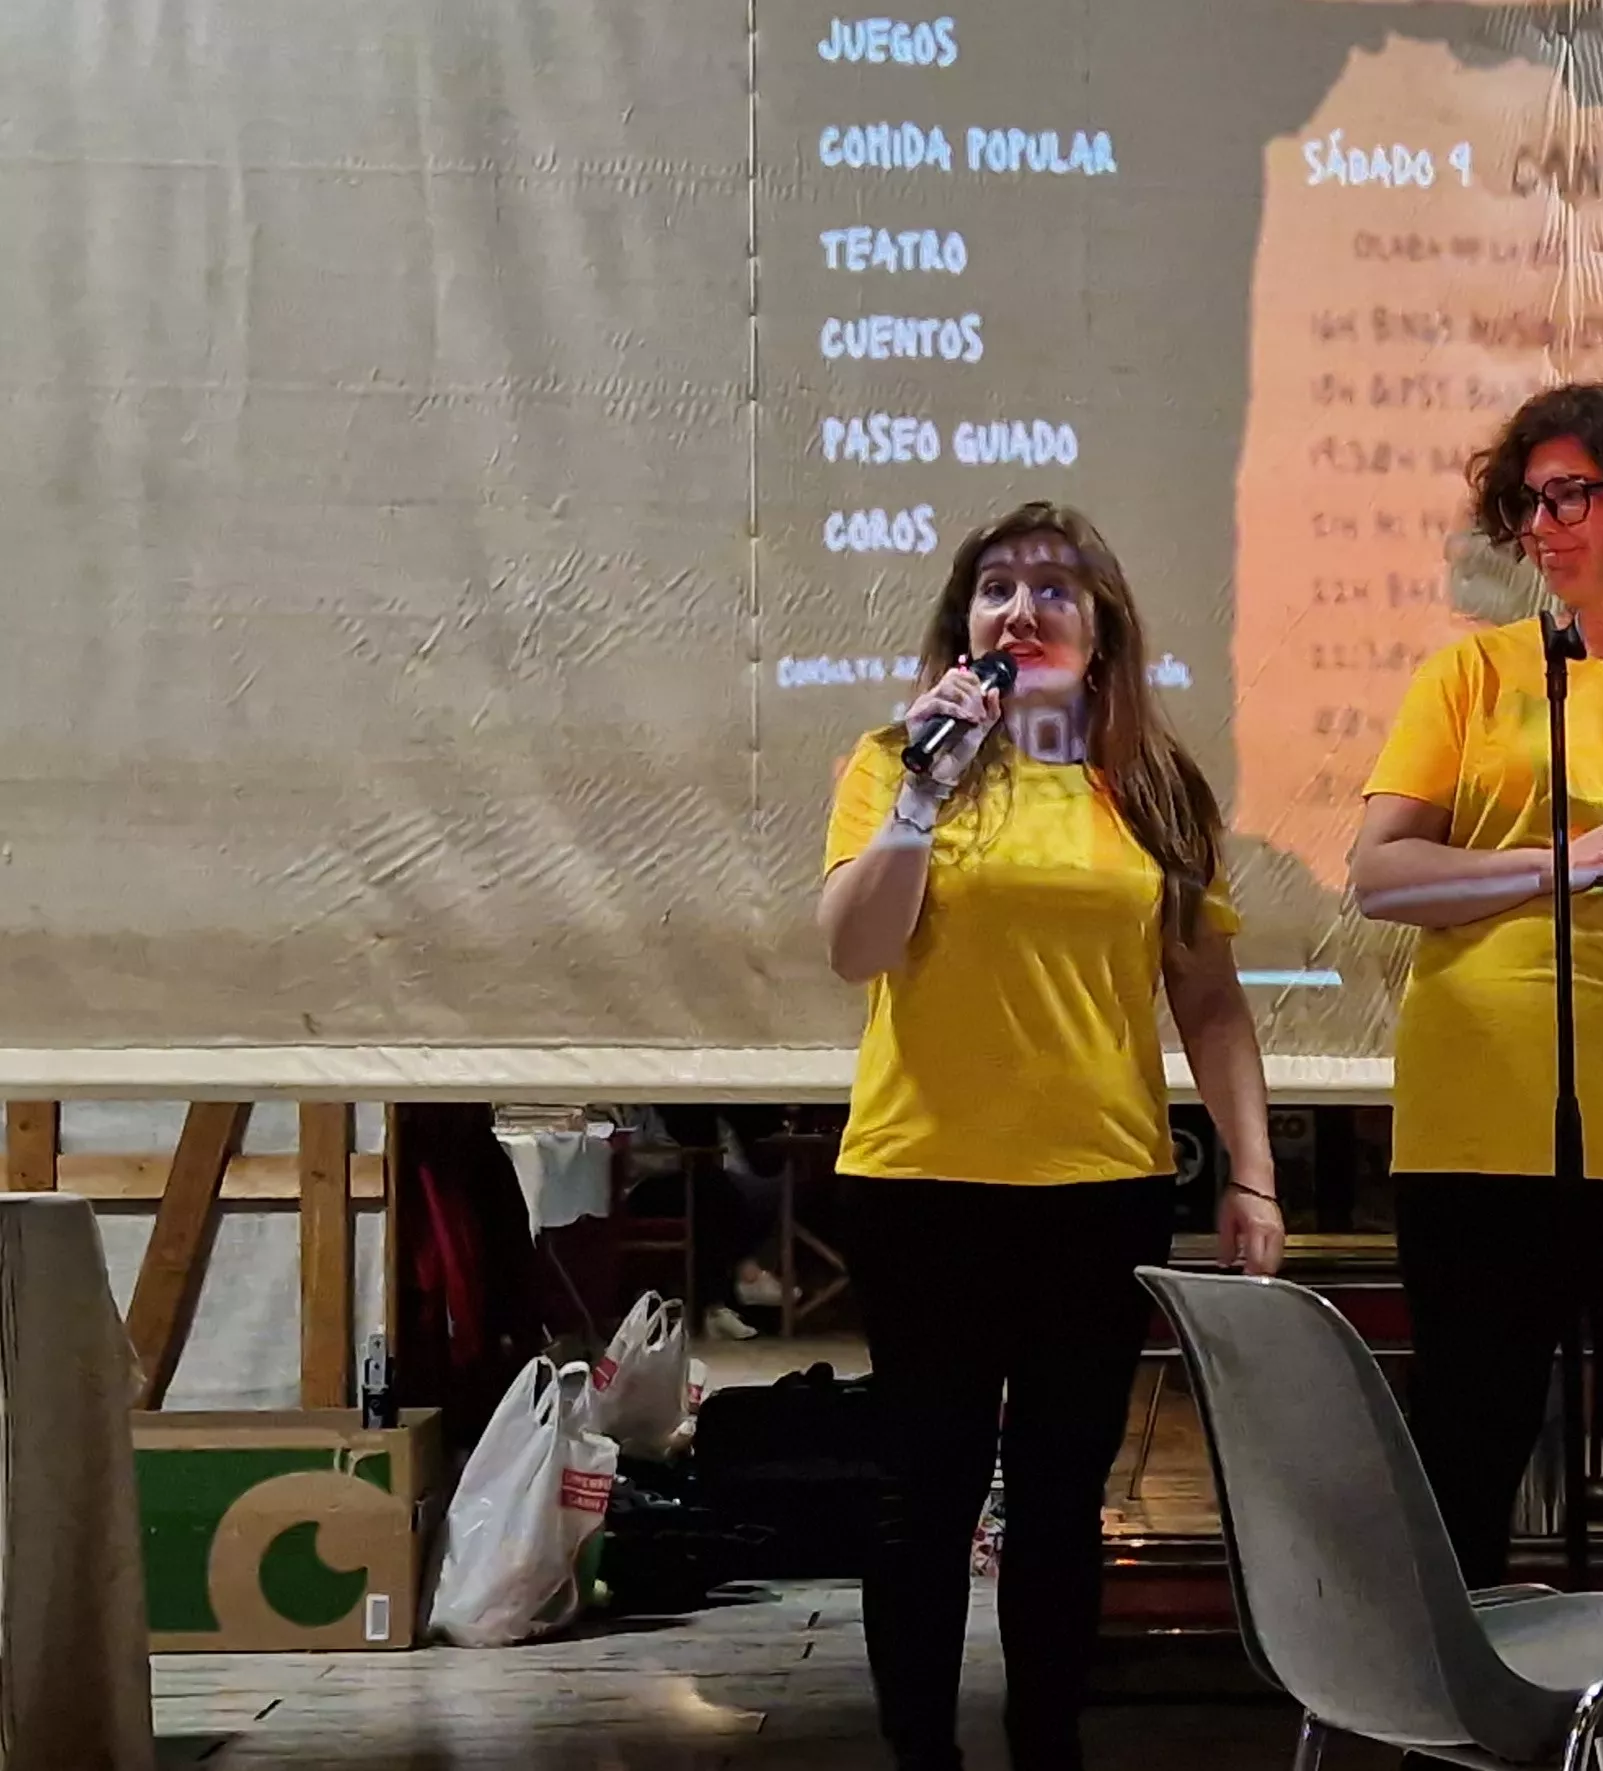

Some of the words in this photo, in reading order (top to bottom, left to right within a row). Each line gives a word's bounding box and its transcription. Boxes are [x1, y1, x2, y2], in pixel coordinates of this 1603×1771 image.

[817, 16, 959, 68] JUEGOS
[818, 120, 953, 172] COMIDA
[966, 126, 1118, 176] POPULAR
[1449, 141, 1472, 187] 9
[819, 225, 969, 276] TEATRO
[820, 312, 985, 363] CUENTOS
[821, 413, 941, 463] PASEO
[953, 418, 1078, 466] GUIADO
[823, 503, 938, 553] COROS
